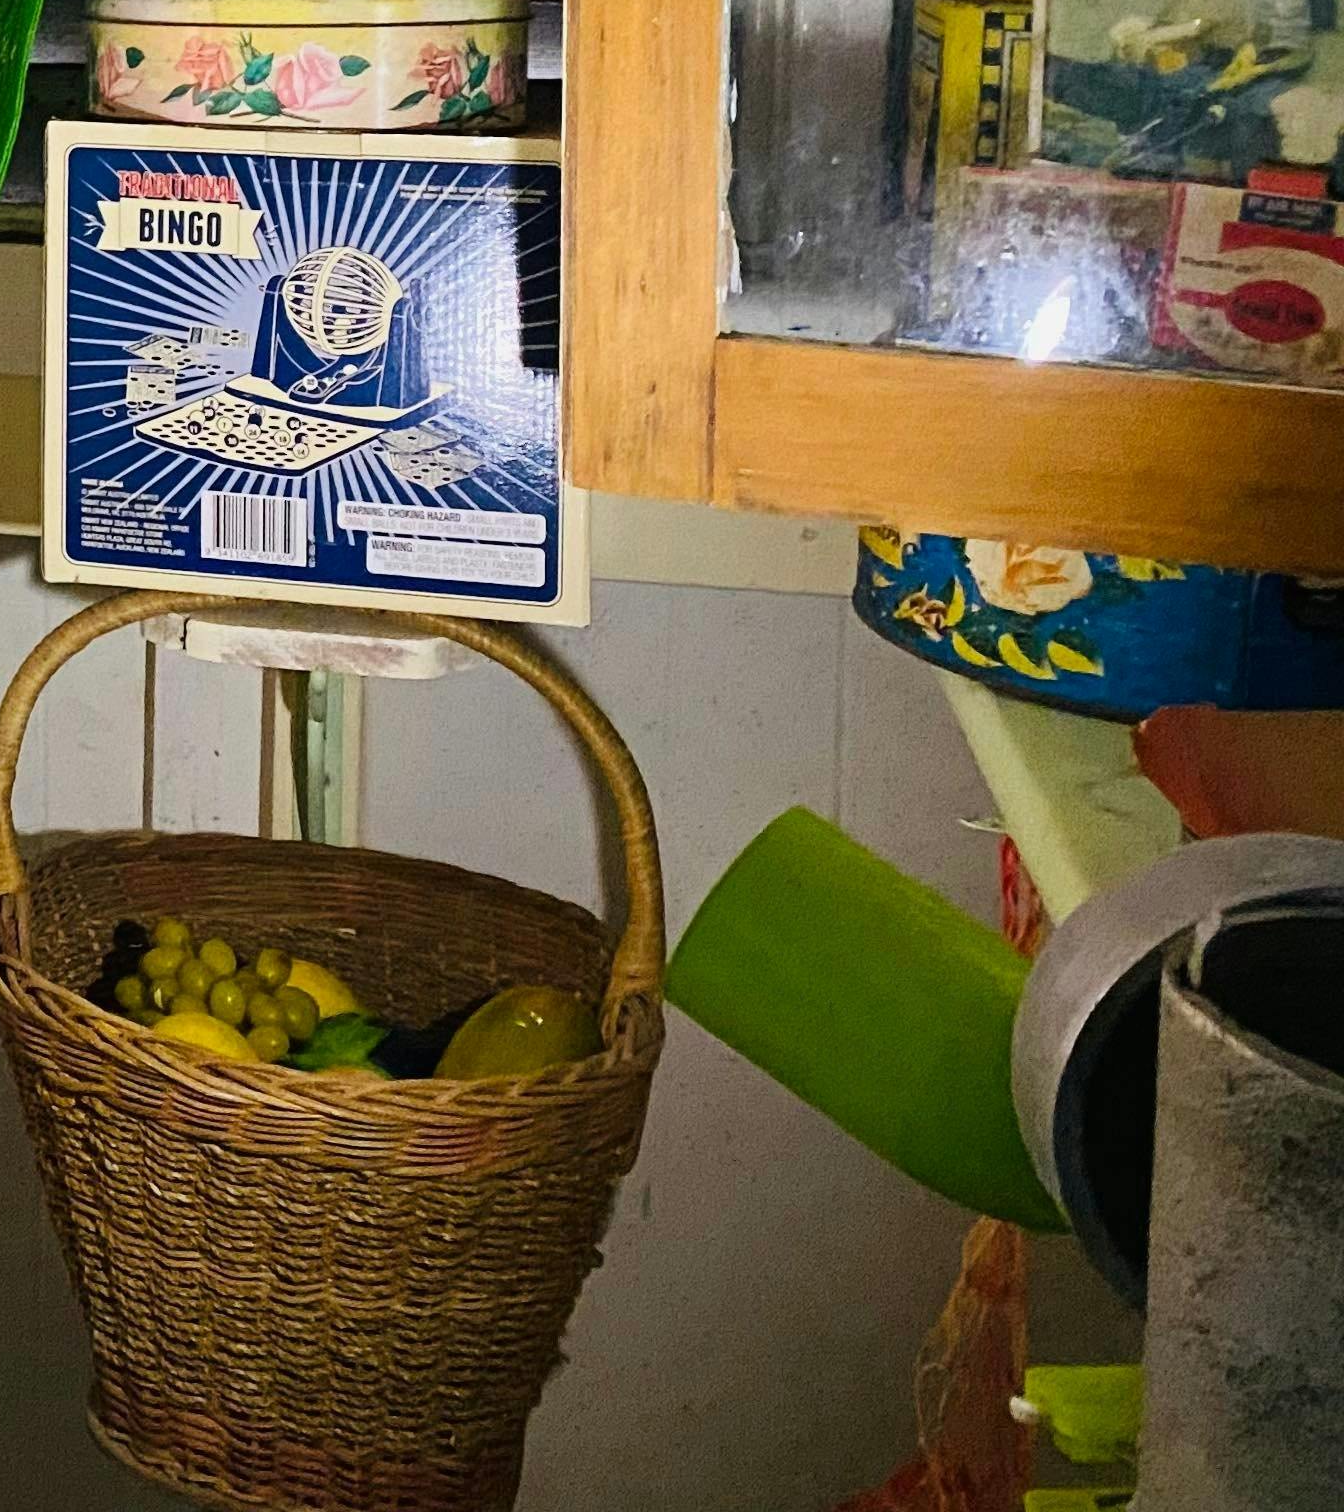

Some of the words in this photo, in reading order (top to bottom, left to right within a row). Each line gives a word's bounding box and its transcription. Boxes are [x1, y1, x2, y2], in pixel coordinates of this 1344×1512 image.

[118, 170, 240, 201] TRADITIONAL
[139, 207, 223, 249] BINGO
[345, 504, 385, 517] WARNING:
[388, 508, 426, 520] CHOKING
[427, 511, 462, 522] HAZARD
[371, 540, 415, 553] WARNING:
